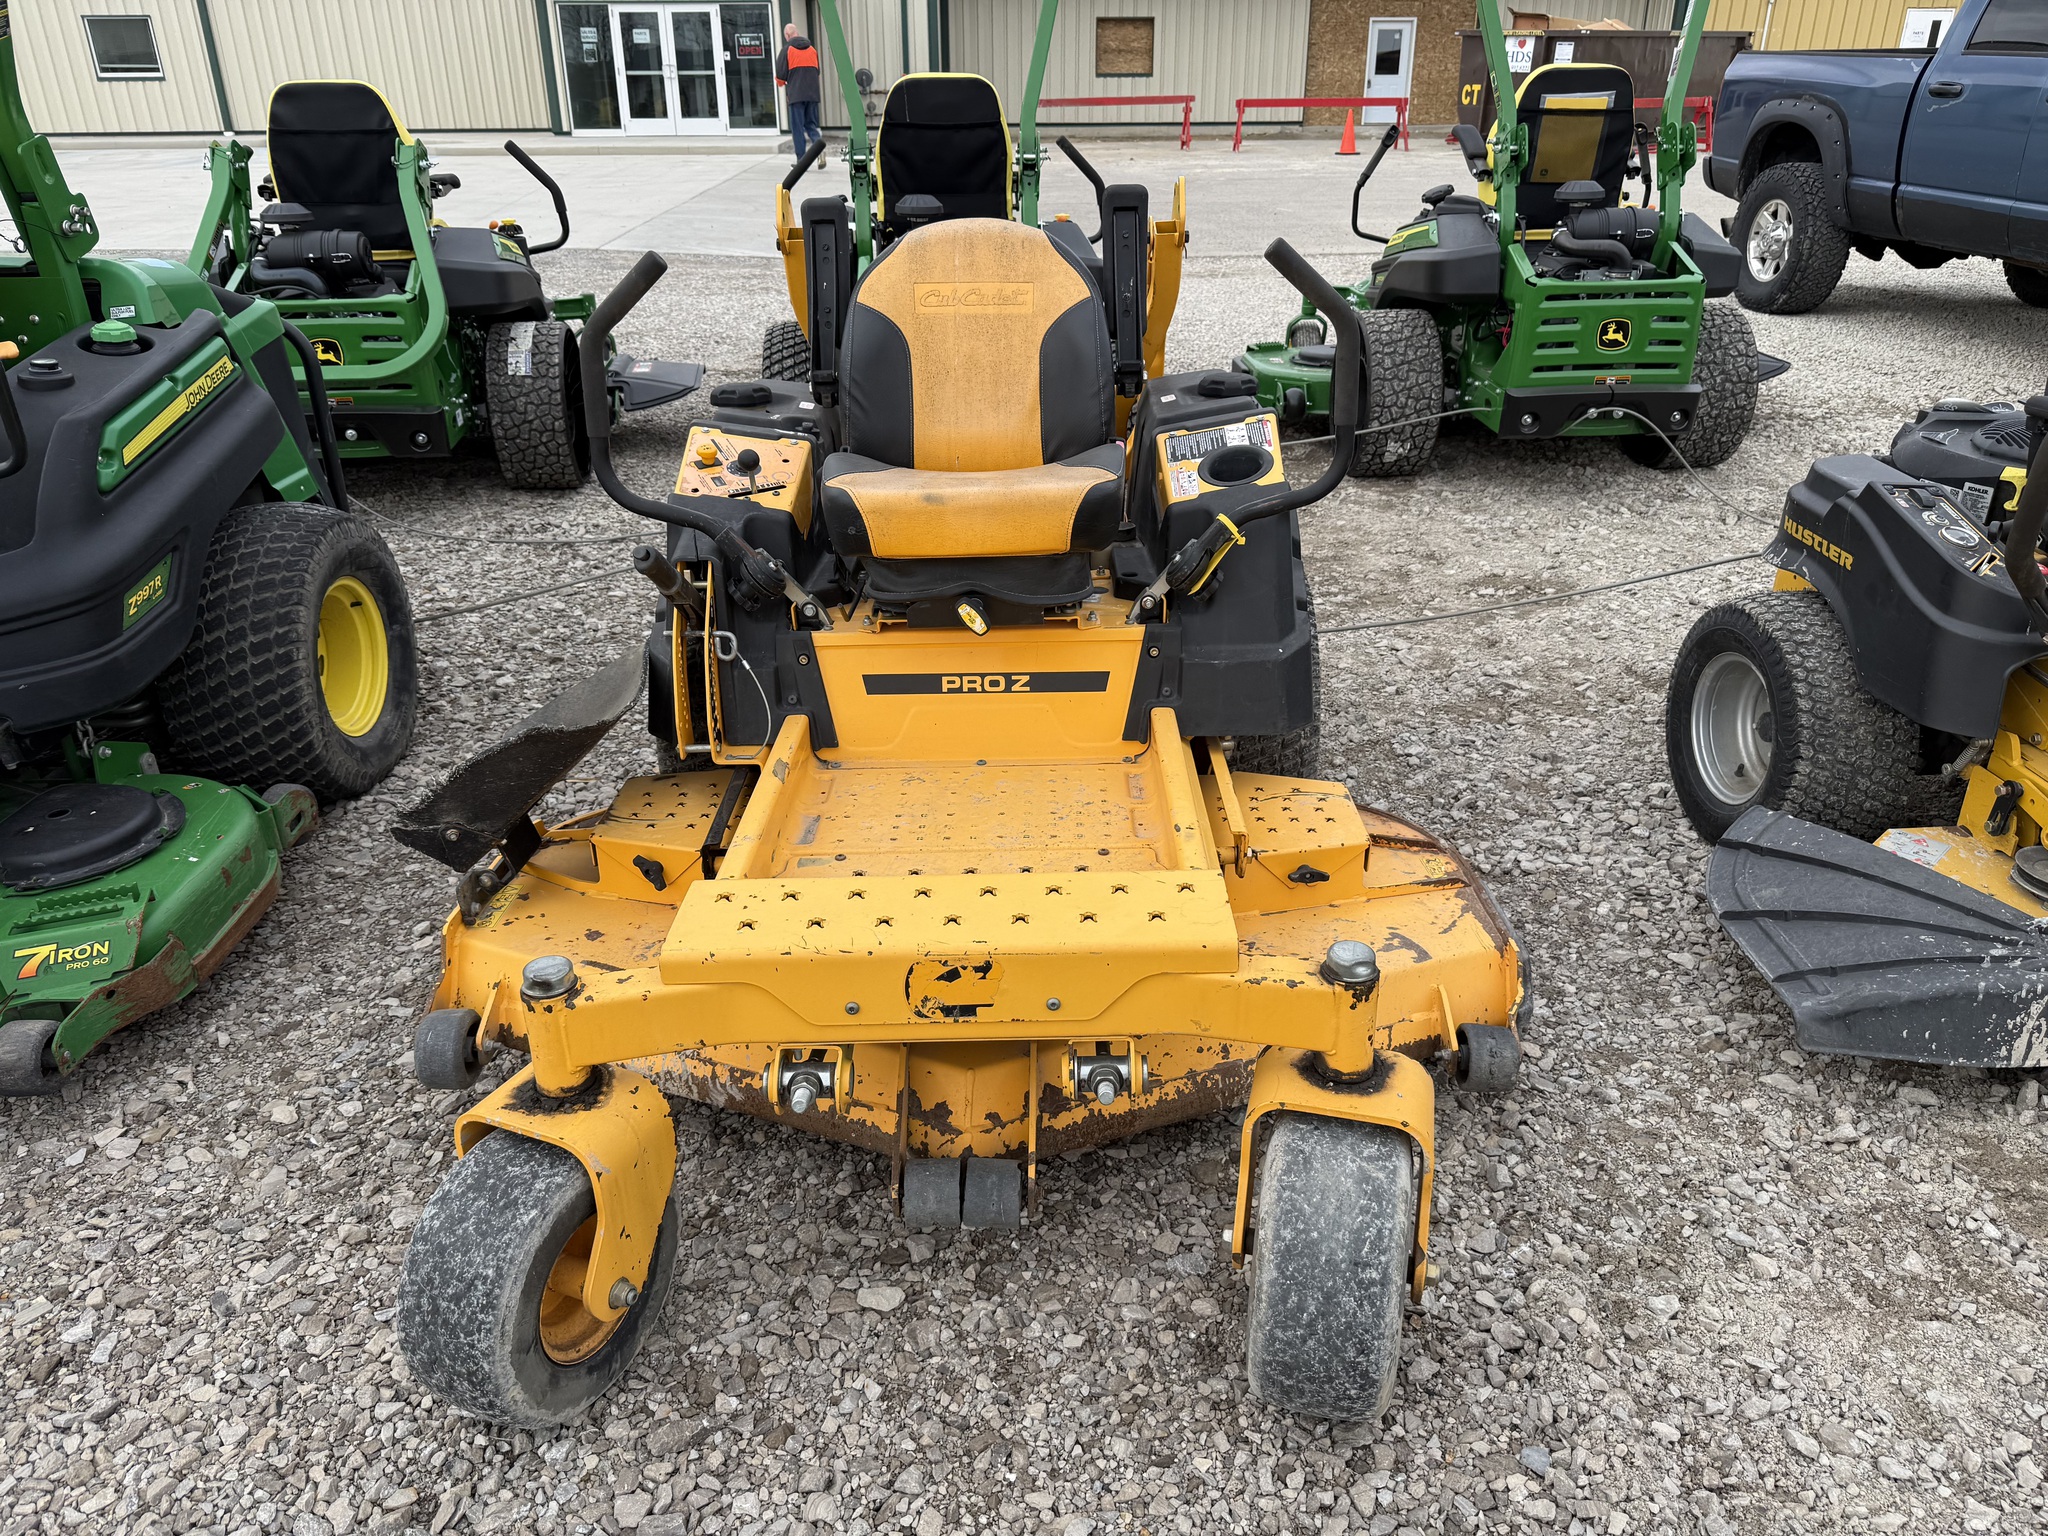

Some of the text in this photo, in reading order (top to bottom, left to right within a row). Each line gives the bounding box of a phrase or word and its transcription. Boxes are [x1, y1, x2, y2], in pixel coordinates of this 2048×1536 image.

[739, 37, 750, 46] YES
[739, 46, 762, 55] OPEN
[1461, 83, 1481, 105] CT
[920, 288, 1029, 308] Cub Cadet
[184, 361, 230, 411] JOHN DEERE
[1967, 485, 1989, 496] KOHLER
[1783, 515, 1855, 571] HUSTLER
[128, 574, 162, 616] Z997R
[942, 675, 1031, 692] PRO Z
[65, 956, 109, 971] PRO 60
